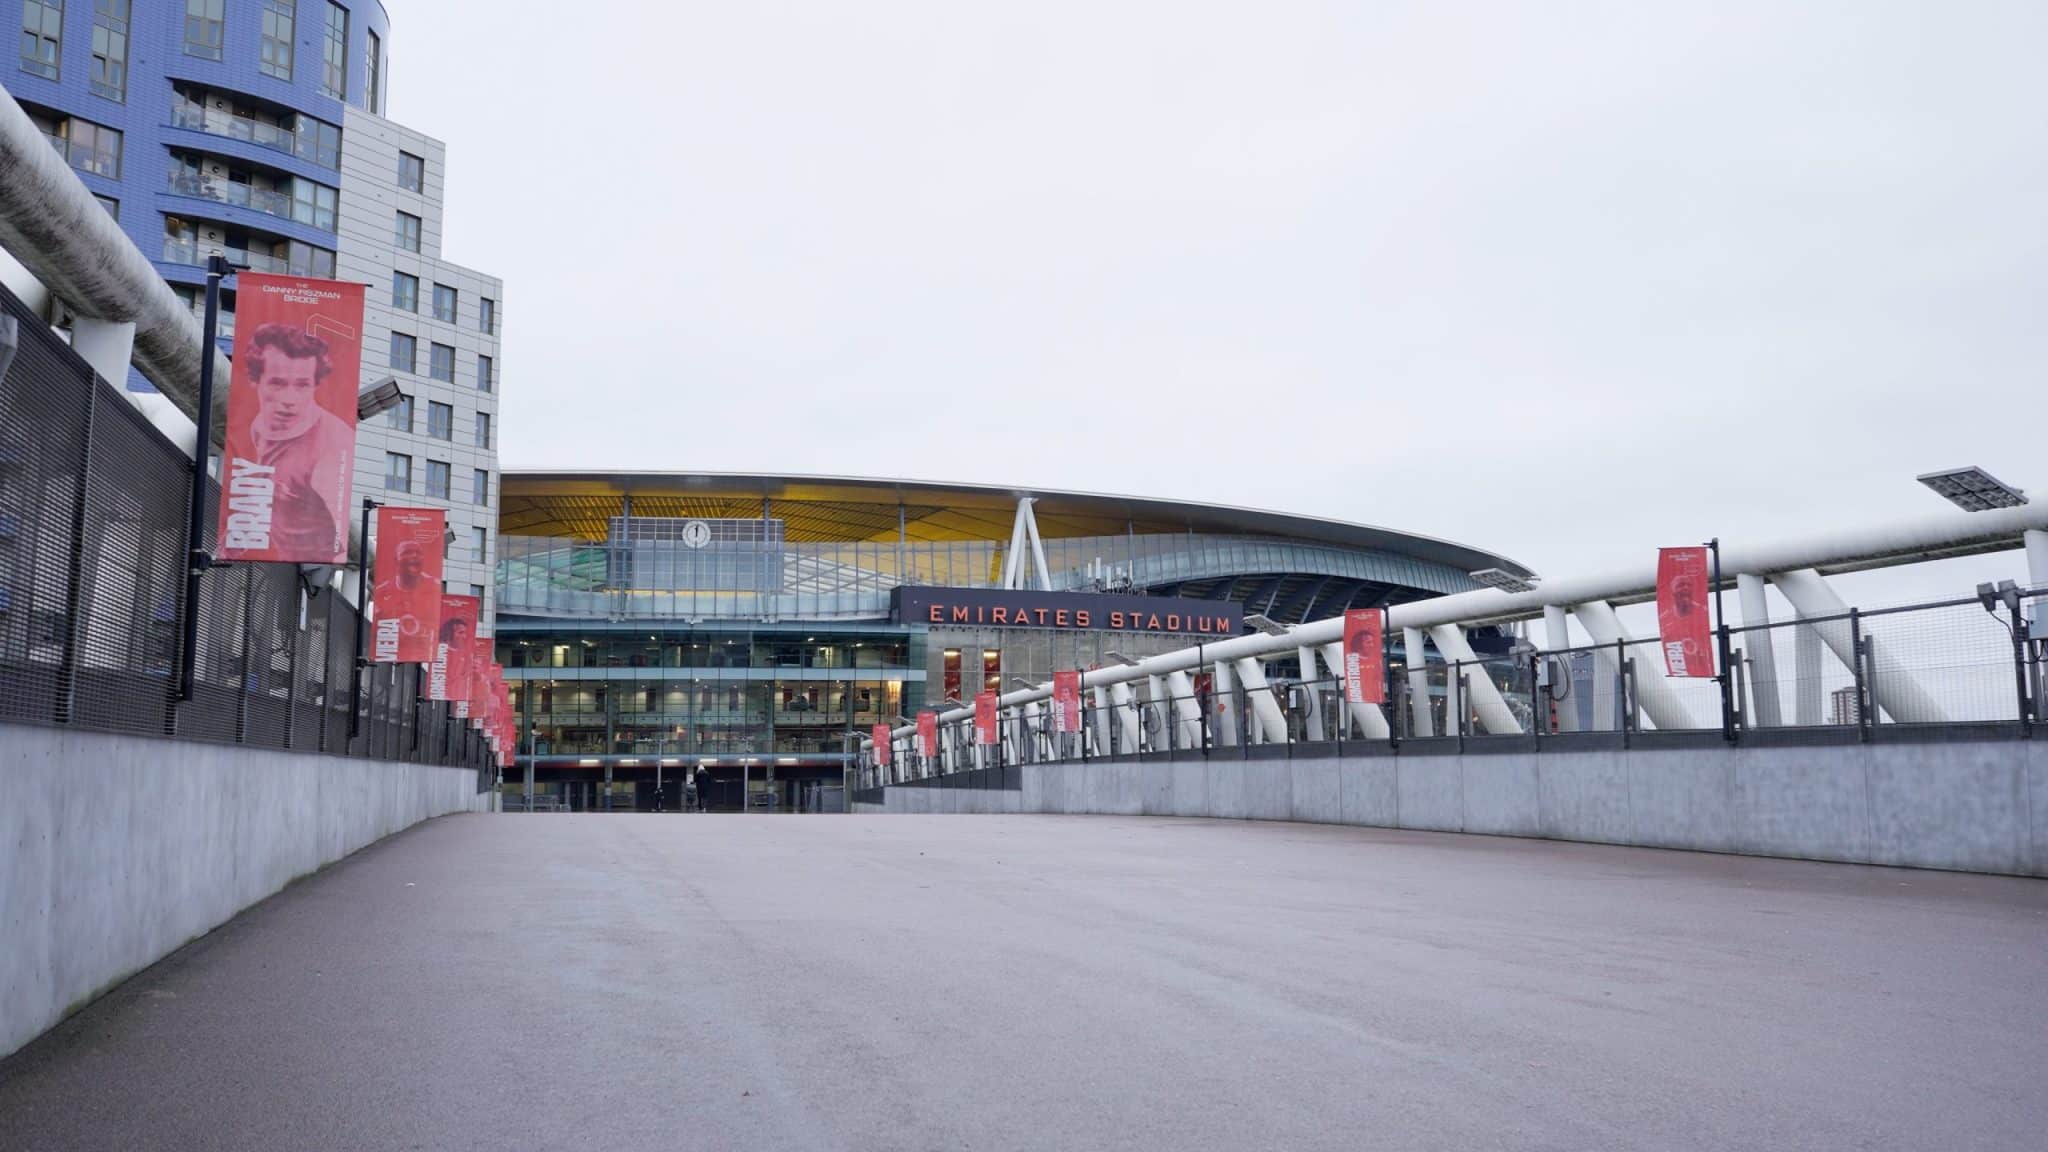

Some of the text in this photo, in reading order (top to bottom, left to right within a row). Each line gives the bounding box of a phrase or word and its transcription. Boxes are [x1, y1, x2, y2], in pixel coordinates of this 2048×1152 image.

[263, 285, 297, 295] DANNY
[225, 457, 276, 550] BRADY
[929, 604, 1230, 633] EMIRATES STADIUM
[374, 618, 400, 662] VIEIRA
